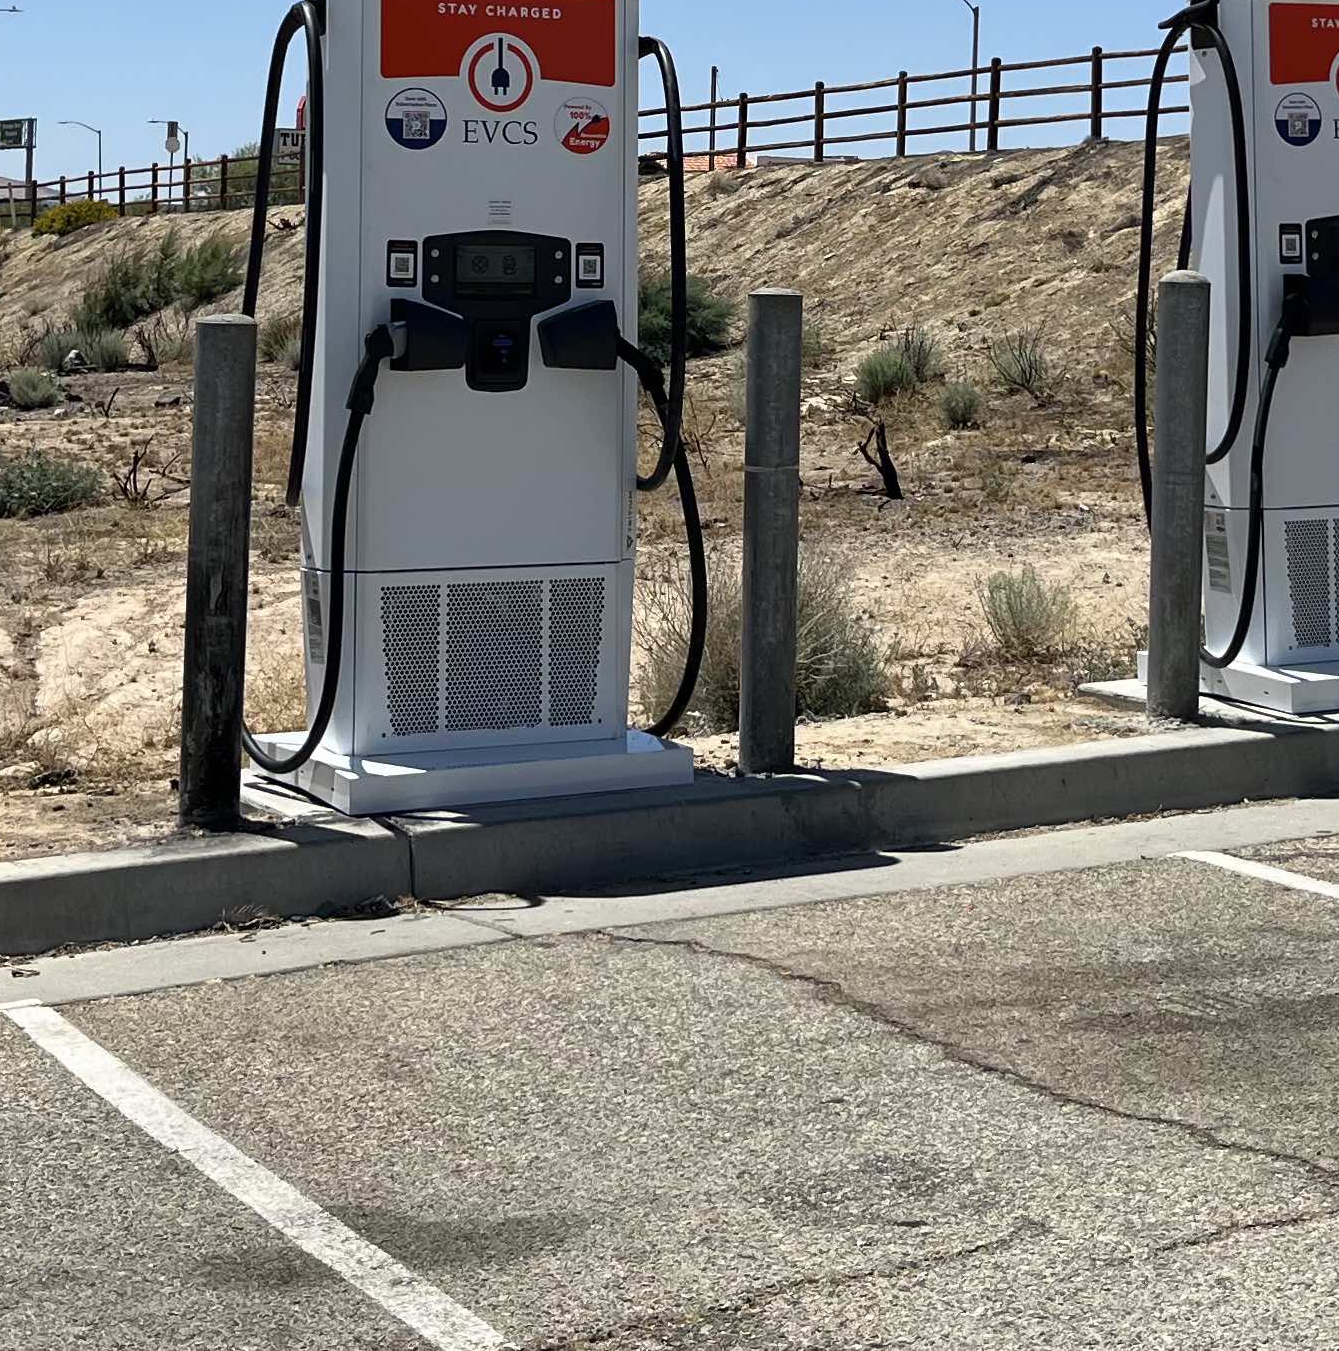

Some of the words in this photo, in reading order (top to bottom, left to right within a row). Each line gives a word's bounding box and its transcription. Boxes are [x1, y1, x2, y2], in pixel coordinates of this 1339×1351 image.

[437, 2, 478, 16] STAY
[485, 5, 562, 20] CHARGED
[462, 120, 538, 145] EVCS
[569, 137, 600, 149] Energy
